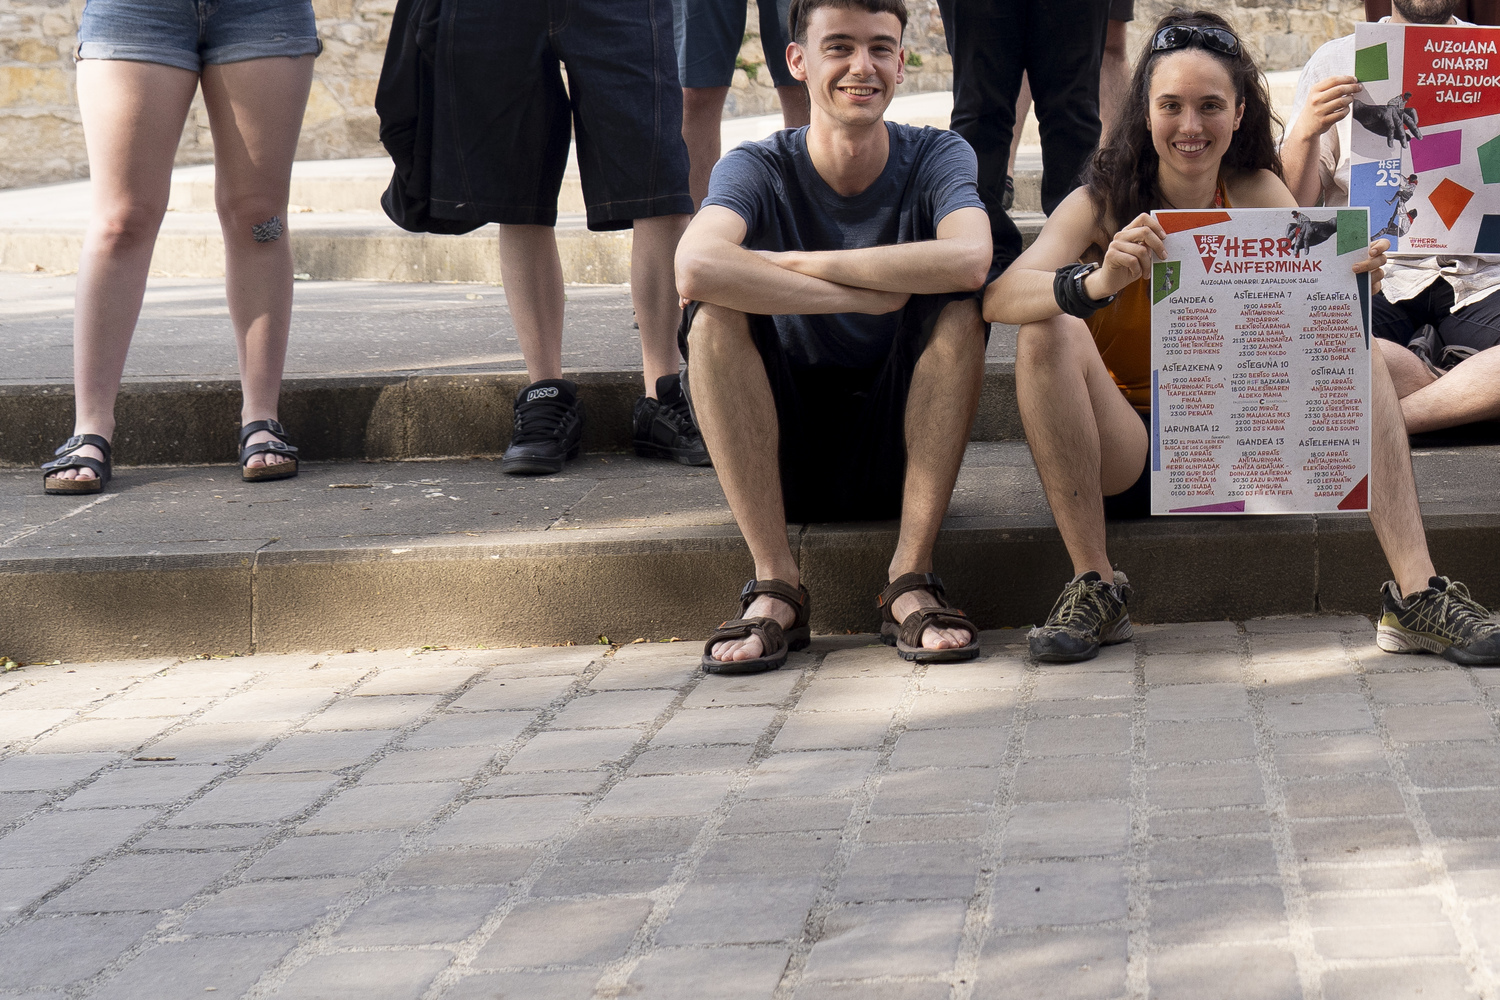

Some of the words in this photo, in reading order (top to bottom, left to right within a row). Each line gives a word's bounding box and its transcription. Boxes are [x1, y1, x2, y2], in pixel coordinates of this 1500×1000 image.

[1425, 39, 1497, 54] AUZOLANA
[1432, 57, 1488, 70] OINARRI
[1417, 73, 1500, 87] ZAPALDUOK
[1436, 90, 1481, 103] JALGI!
[1375, 169, 1401, 187] 25
[1200, 244, 1219, 257] 25
[1214, 259, 1322, 274] SANFERMINAK
[1234, 290, 1285, 299] ASTELEHENA
[1307, 292, 1350, 301] ASTEARTEA
[1162, 363, 1215, 371] ASTEAZKENA
[1237, 360, 1278, 368] OSTEGUNA
[1311, 366, 1345, 375] OSTIRALA
[1164, 425, 1209, 433] LARUNBATA
[1299, 438, 1350, 447] ASTELEHENA
